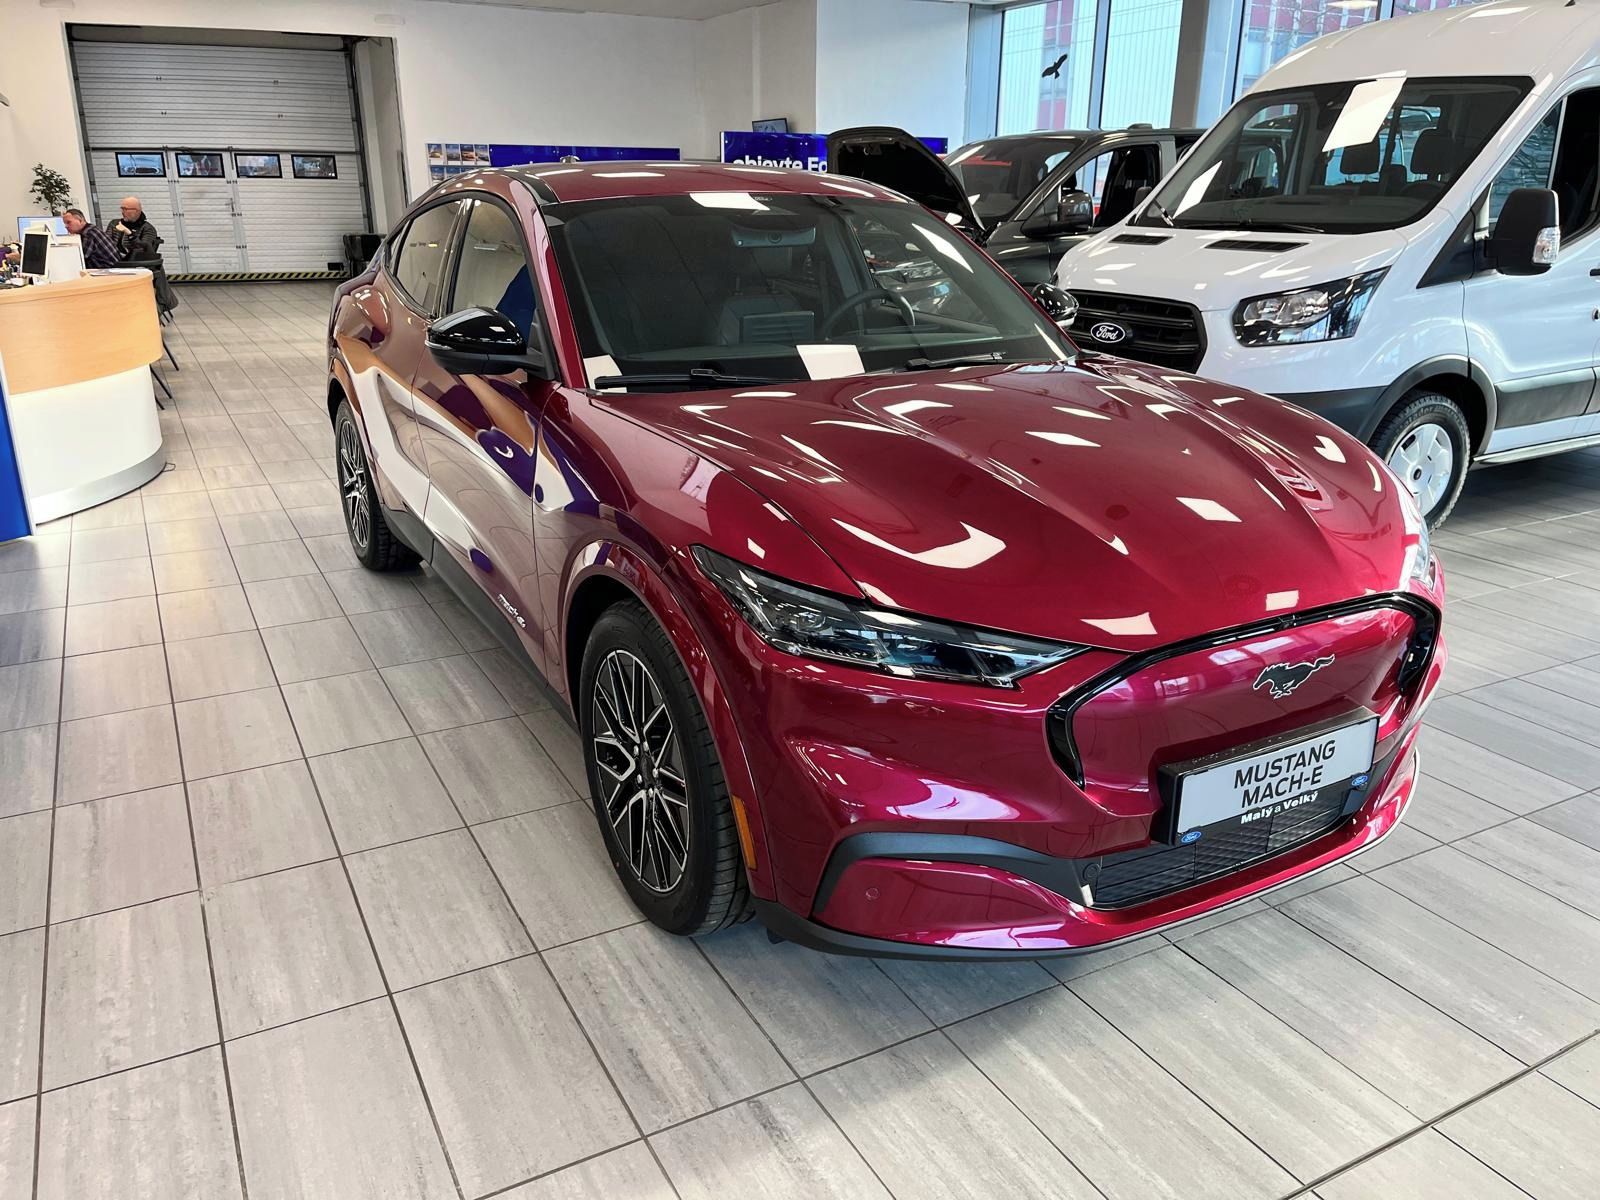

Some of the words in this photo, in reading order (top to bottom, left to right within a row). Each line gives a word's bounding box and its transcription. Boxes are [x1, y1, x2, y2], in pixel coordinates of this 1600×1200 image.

[1095, 325, 1119, 340] Ford
[1234, 740, 1336, 789] MUSTANG
[1241, 765, 1324, 808] MACH-E
[1241, 806, 1274, 824] Malý
[1274, 805, 1281, 813] a
[1283, 791, 1319, 810] Velký
